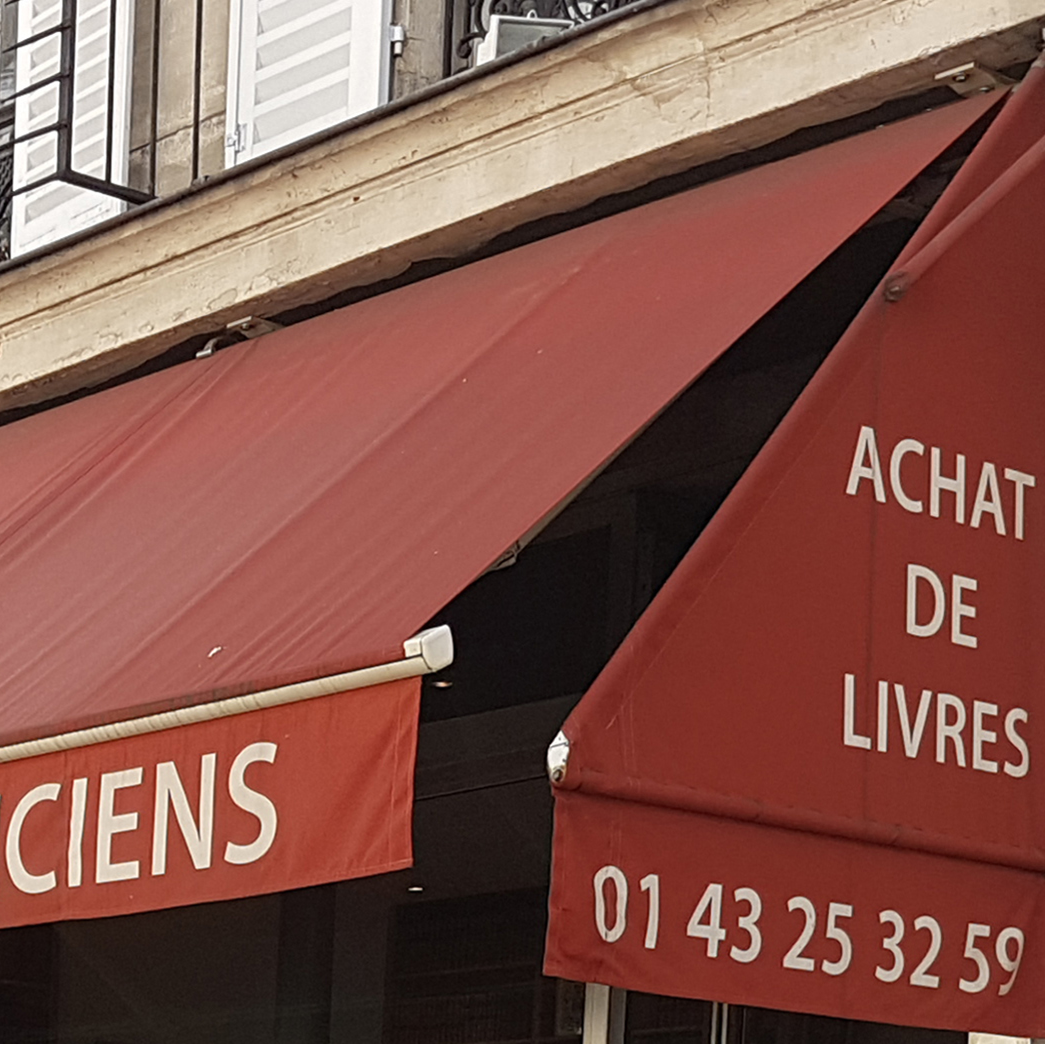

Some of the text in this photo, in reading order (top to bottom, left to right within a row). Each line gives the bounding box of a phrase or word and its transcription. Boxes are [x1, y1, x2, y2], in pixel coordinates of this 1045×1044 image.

[845, 424, 1037, 541] ACHAT
[905, 562, 978, 650] DE
[843, 672, 1031, 779] LIVRES
[593, 865, 1025, 997] 01 43 25 32 59
